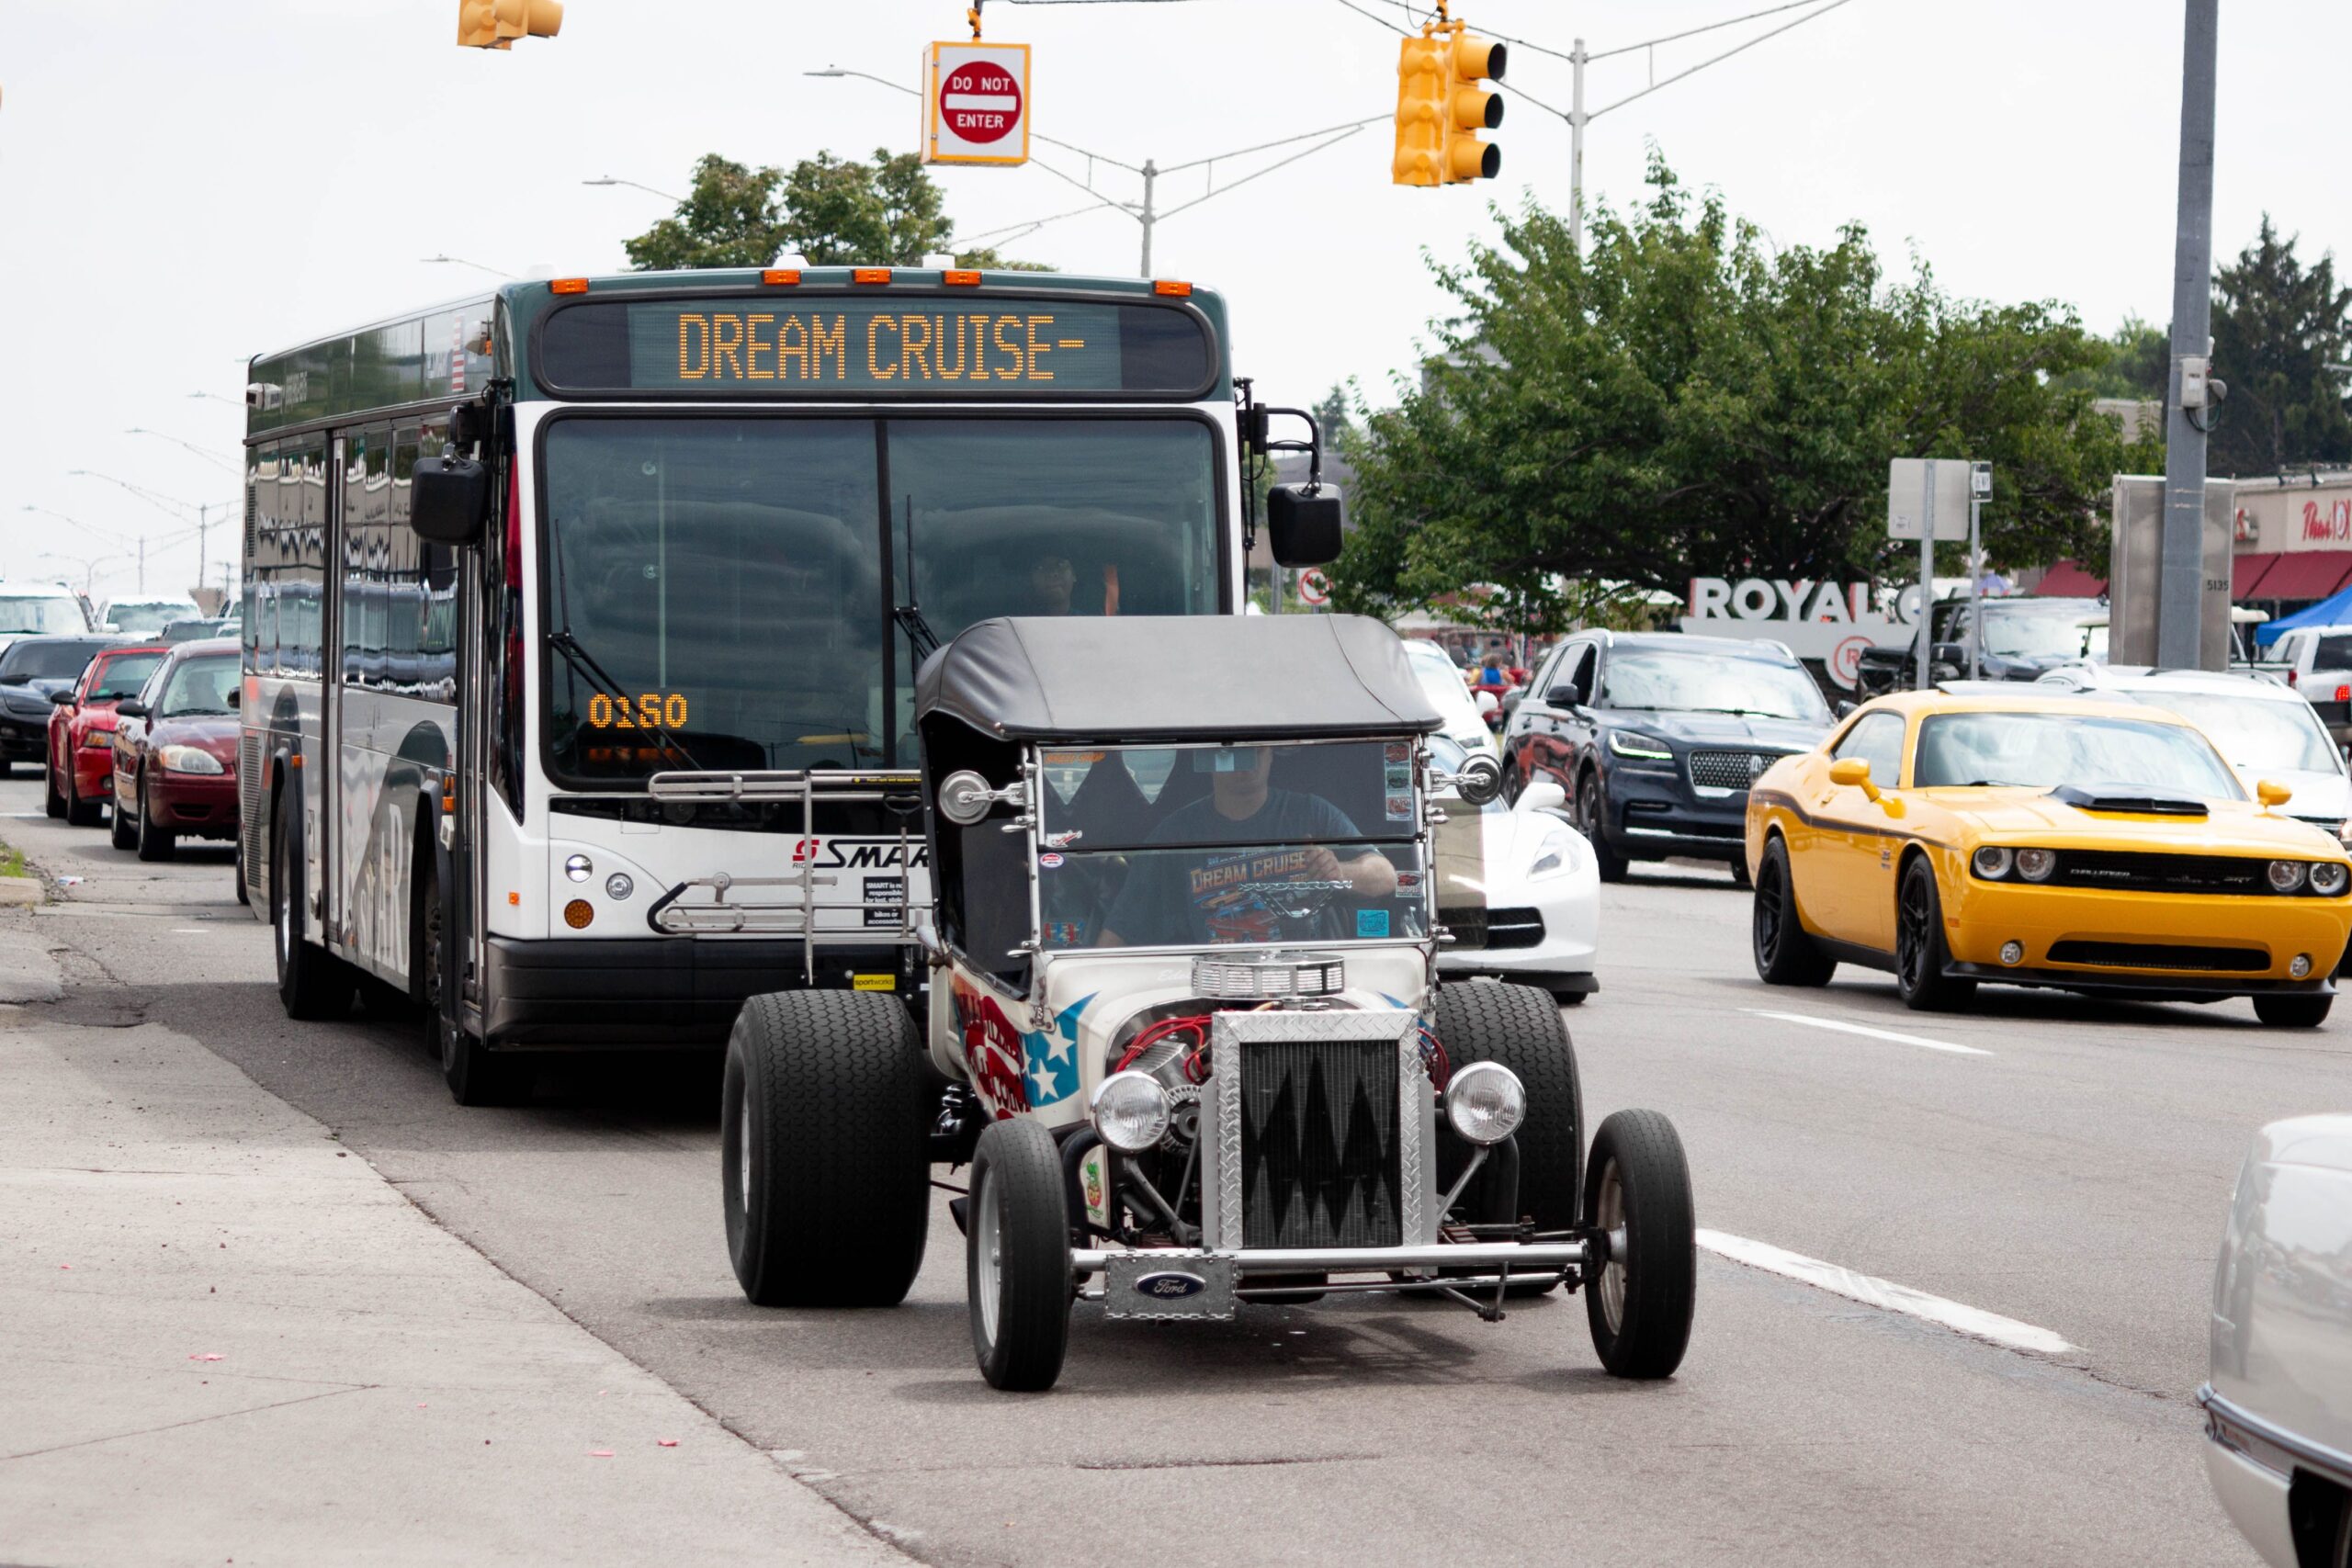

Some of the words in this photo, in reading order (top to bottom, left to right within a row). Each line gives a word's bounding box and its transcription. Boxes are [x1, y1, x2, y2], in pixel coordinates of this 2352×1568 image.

[953, 76, 972, 91] DO
[981, 77, 1011, 91] NOT
[957, 114, 1004, 129] ENTER
[679, 314, 845, 379] DREAM
[867, 315, 1085, 379] CRUISE-
[2207, 580, 2229, 592] 5135
[1689, 577, 1884, 624] ROYAL
[813, 839, 929, 868] SMAR
[1190, 863, 1248, 894] DREAM
[1252, 851, 1308, 876] CRUISE
[1153, 1279, 1189, 1293] Ford
